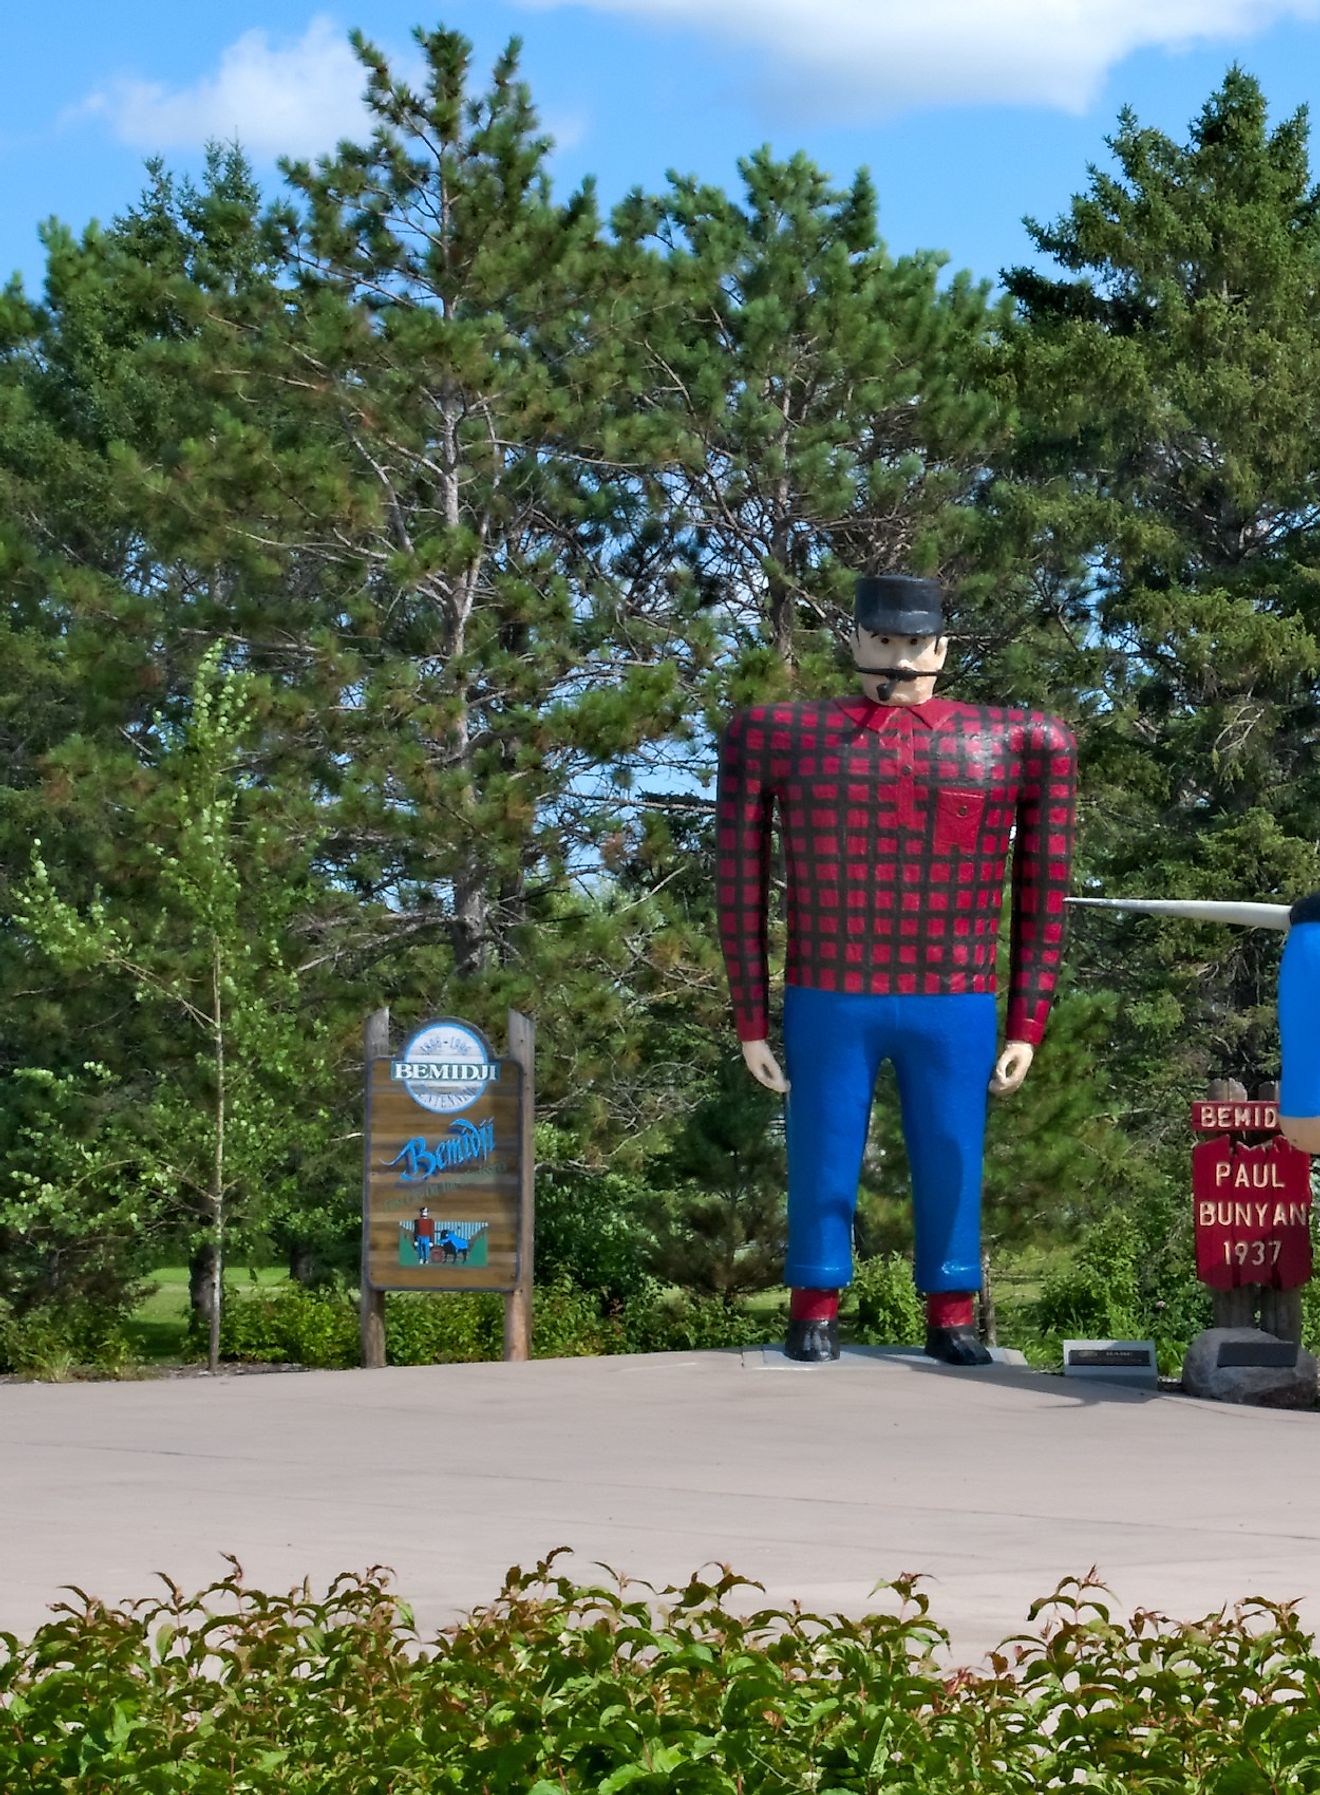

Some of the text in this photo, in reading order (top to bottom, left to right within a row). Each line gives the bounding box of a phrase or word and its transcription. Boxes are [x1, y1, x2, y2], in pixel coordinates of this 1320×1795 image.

[395, 1063, 497, 1081] BEMIDJI
[1200, 1105, 1276, 1128] BEMID
[379, 1117, 495, 1181] Bemidji
[1216, 1163, 1285, 1188] PAUL
[1199, 1202, 1307, 1227] BUNYAN
[1223, 1241, 1281, 1265] 1937
